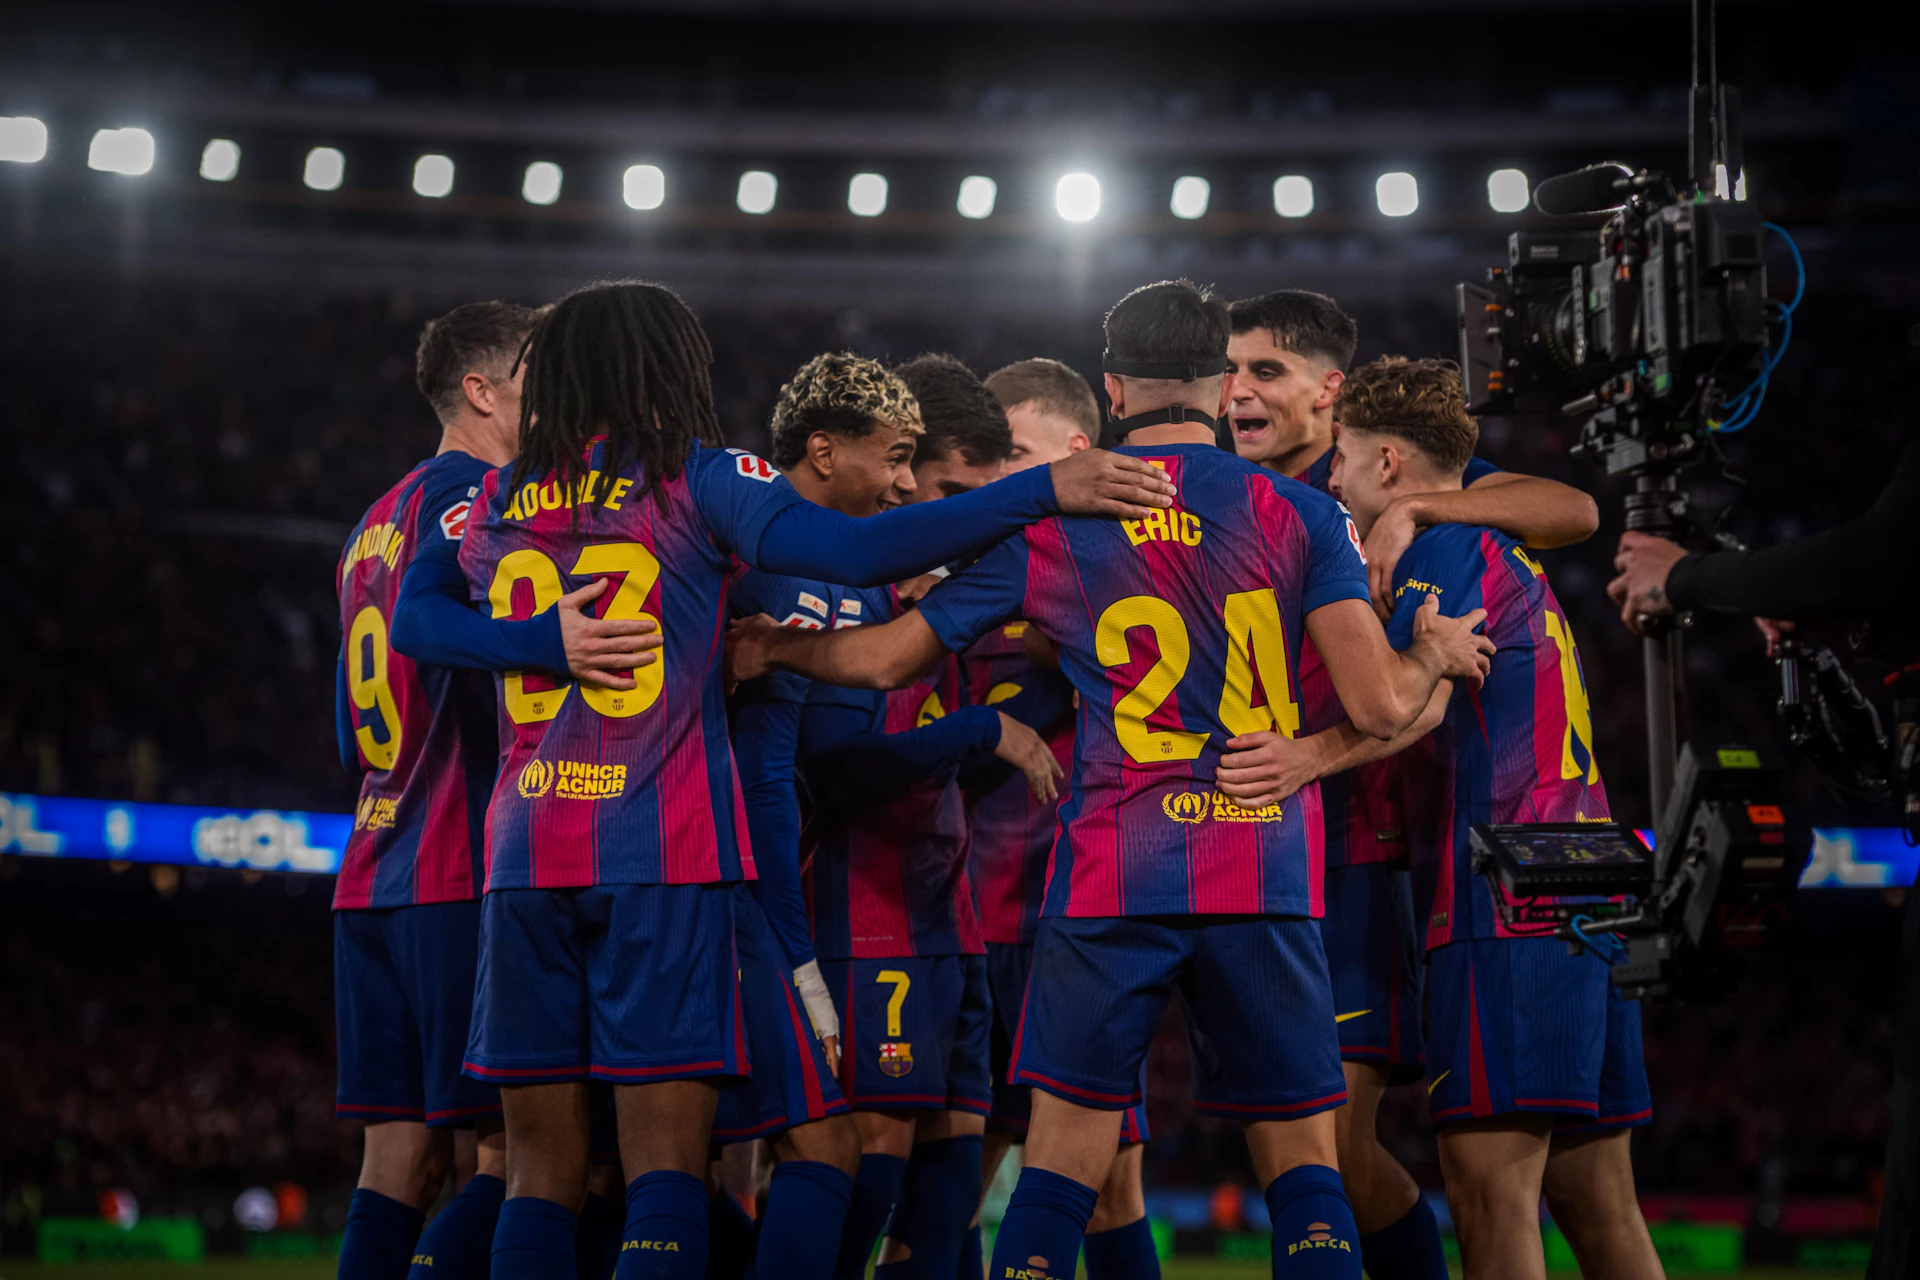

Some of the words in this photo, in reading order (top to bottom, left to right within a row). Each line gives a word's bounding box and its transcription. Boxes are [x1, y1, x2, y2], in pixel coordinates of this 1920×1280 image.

[1119, 506, 1203, 547] ERIC
[348, 605, 403, 771] 9
[1095, 588, 1301, 765] 24
[555, 777, 625, 794] ACNUR
[558, 760, 627, 779] UNHCR
[875, 969, 911, 1037] 7
